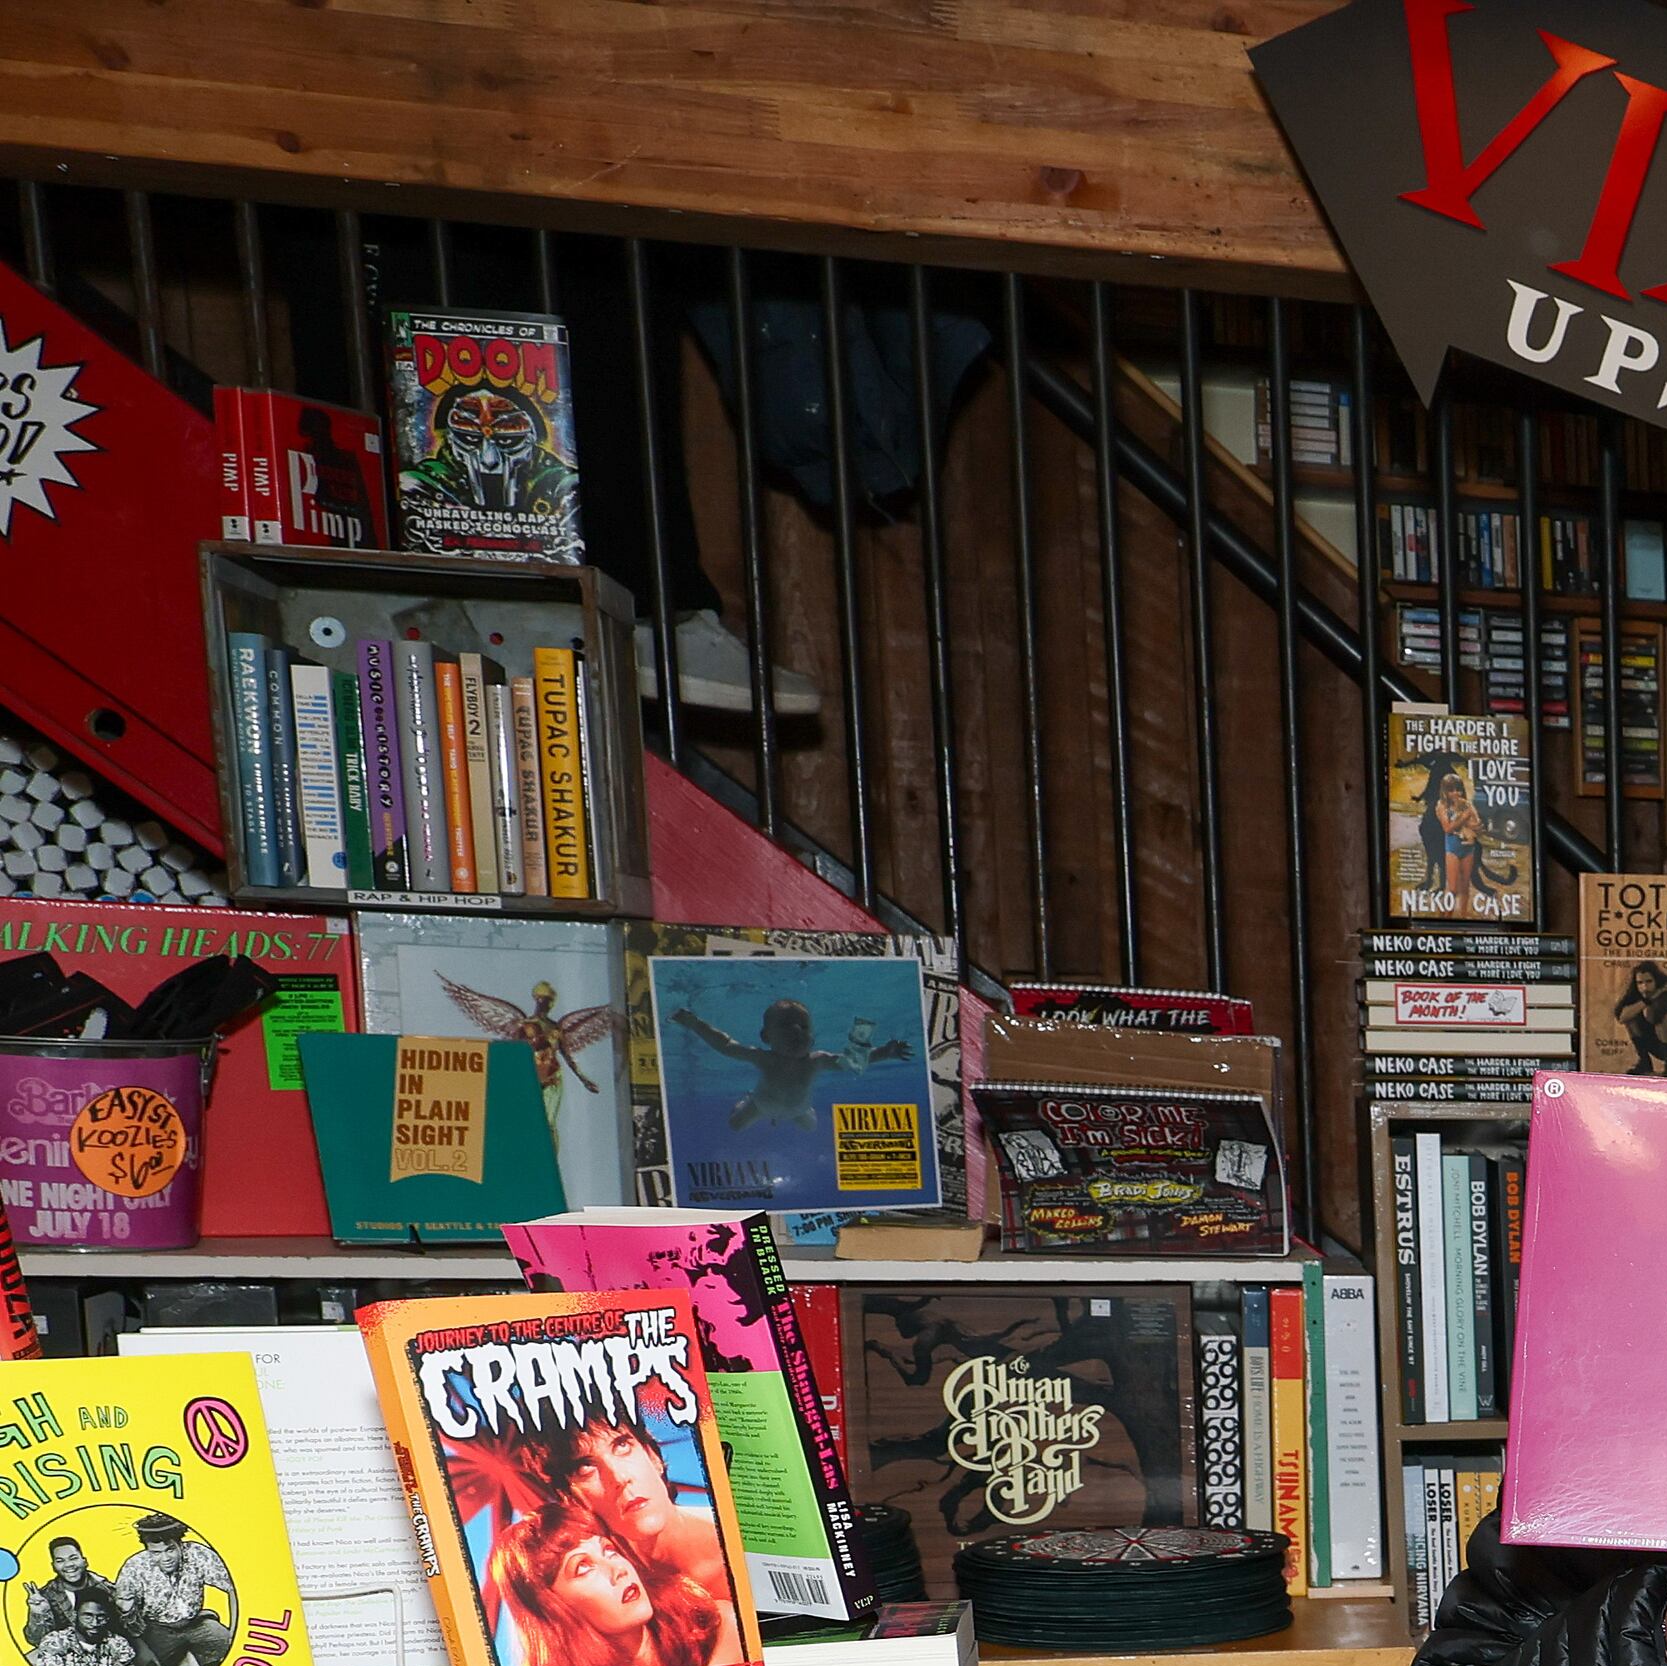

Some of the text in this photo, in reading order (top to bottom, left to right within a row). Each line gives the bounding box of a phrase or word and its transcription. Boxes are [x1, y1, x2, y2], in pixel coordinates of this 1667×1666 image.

[413, 319, 536, 337] THE CHRONICLES OF
[413, 335, 560, 402] DOOM
[288, 449, 362, 549] Pimp
[469, 719, 480, 736] 2
[1405, 718, 1510, 737] THE HARDER I
[1406, 734, 1519, 756] FIGHT THE MORE
[541, 674, 577, 878] TUPAC SHAKUR
[1478, 758, 1517, 782] LOVE
[1484, 785, 1521, 808] YOU
[353, 890, 497, 907] RAP HIP HOP
[1402, 889, 1522, 917] NEKO CASE
[0, 920, 342, 962] ALKING 77
[1373, 935, 1453, 953] NEKO CASE
[1374, 959, 1455, 977] NEKO CASE
[1102, 1009, 1212, 1027] WHAT THE
[400, 1049, 484, 1074] HIDING
[1374, 1057, 1455, 1075] NEKO CASE
[399, 1074, 424, 1096] IN
[1374, 1082, 1455, 1101] NEKO CASE
[397, 1099, 471, 1122] PLAIN
[838, 1107, 915, 1131] NIRVANA
[396, 1124, 470, 1147] SIGHT
[1394, 1153, 1416, 1266] ESTRUS
[1506, 1171, 1521, 1264] BOB DYLAN
[29, 1211, 130, 1239] JULY 18
[1470, 1181, 1489, 1276] BOB DYLAN
[750, 1226, 777, 1295] IN BLACK
[758, 1224, 785, 1294] DRESSED
[1331, 1288, 1365, 1300] ABBA
[416, 1313, 601, 1353] JOURNEY TO THE CENTRE
[624, 1308, 676, 1347] THE
[255, 1353, 281, 1364] FOR
[419, 1335, 698, 1439] CRAMPS
[943, 1355, 1074, 1426] Allman
[79, 1405, 129, 1431] AND
[948, 1403, 1106, 1472] Brothers
[986, 1439, 1085, 1526] Band
[836, 1501, 854, 1530] LISA
[1426, 1483, 1437, 1523] LOSER
[1440, 1483, 1452, 1524] LOSER
[827, 1502, 857, 1578] MACKINNEY
[1416, 1571, 1429, 1627] NIRVANA
